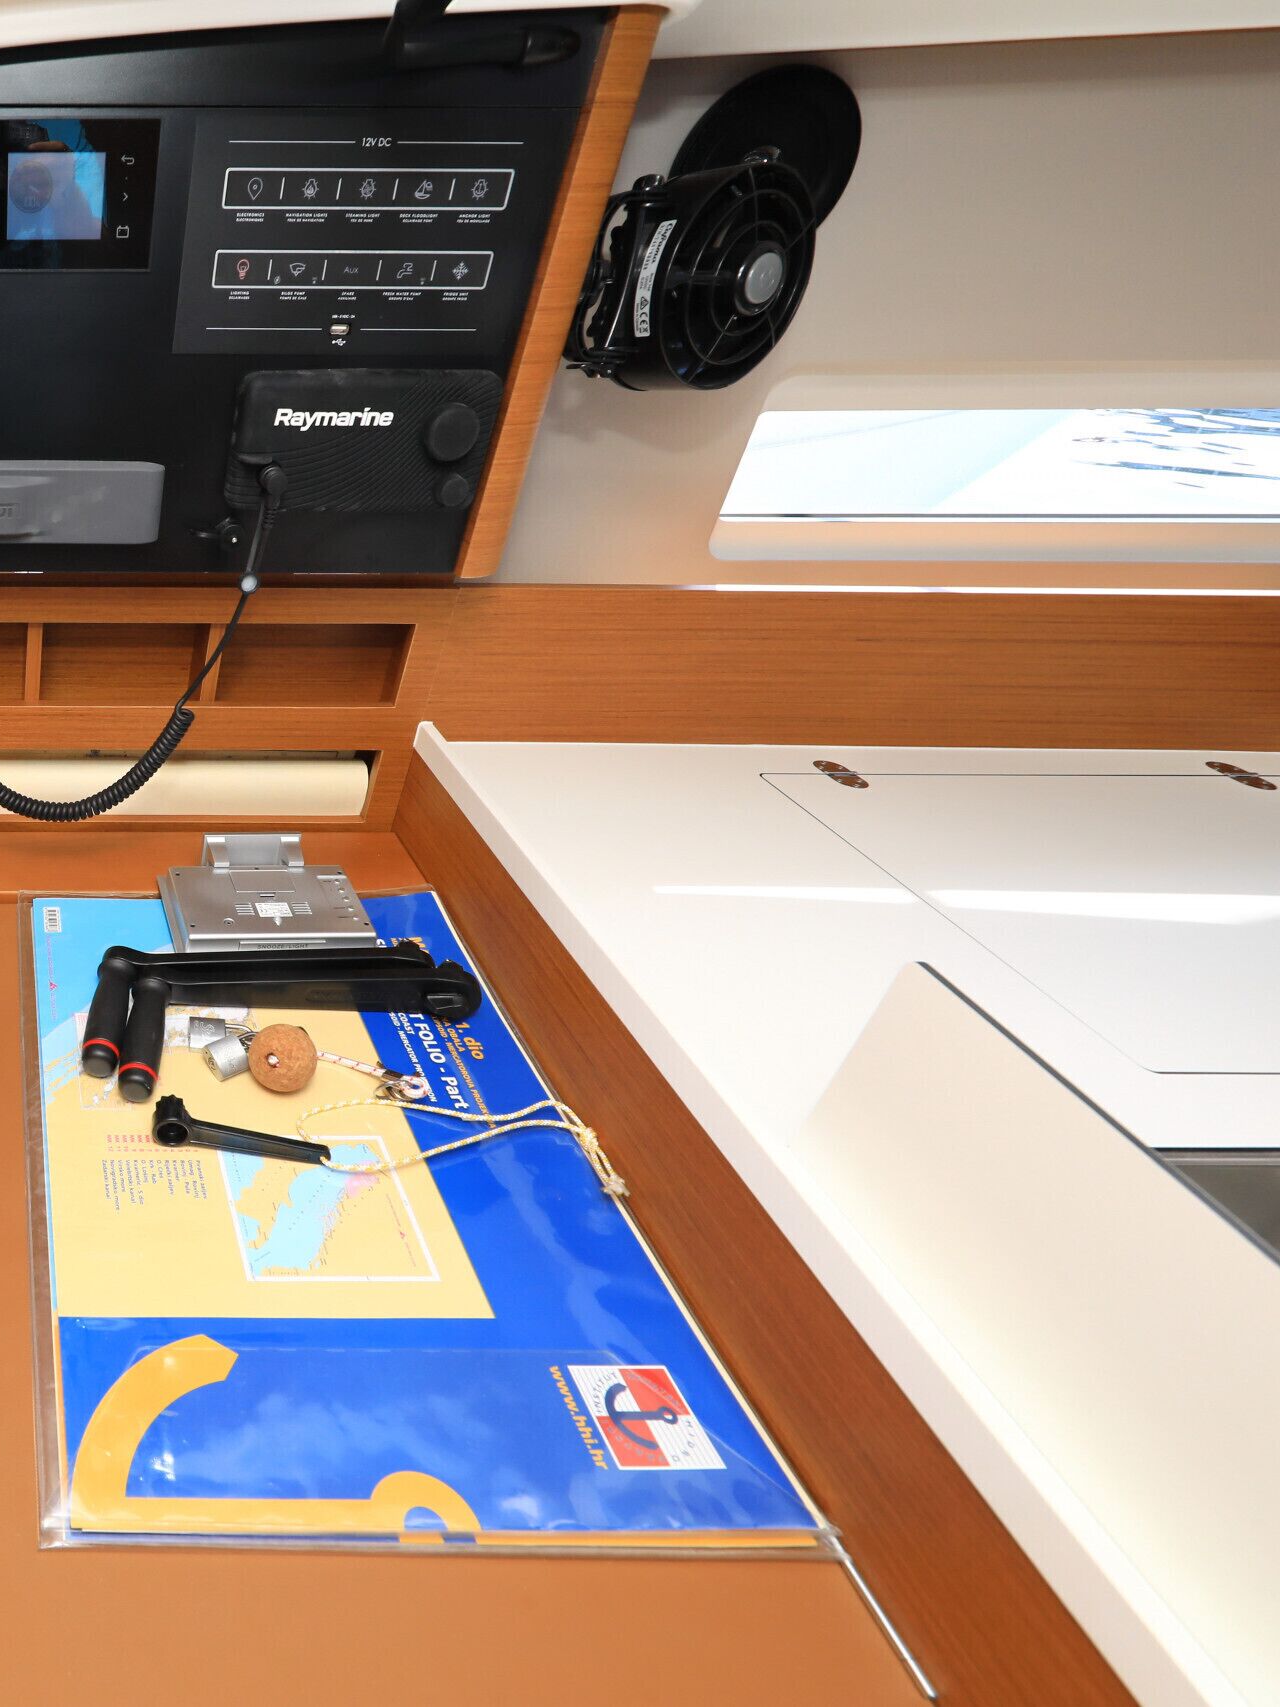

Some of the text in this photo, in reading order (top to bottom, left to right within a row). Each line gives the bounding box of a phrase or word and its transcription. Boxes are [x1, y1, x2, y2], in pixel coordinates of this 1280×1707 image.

[361, 137, 392, 148] 12V DC
[343, 265, 359, 275] Aux
[273, 406, 395, 431] Raymarine
[397, 1012, 415, 1035] COAST
[397, 1030, 419, 1063] MERCATOR
[447, 1028, 466, 1052] OBALA
[455, 1021, 484, 1060] 1. dio
[413, 1022, 446, 1064] FOLIO
[440, 1076, 470, 1109] Part
[446, 1042, 475, 1089] MERCATOROVA
[548, 1365, 609, 1470] www.hhi.hr
